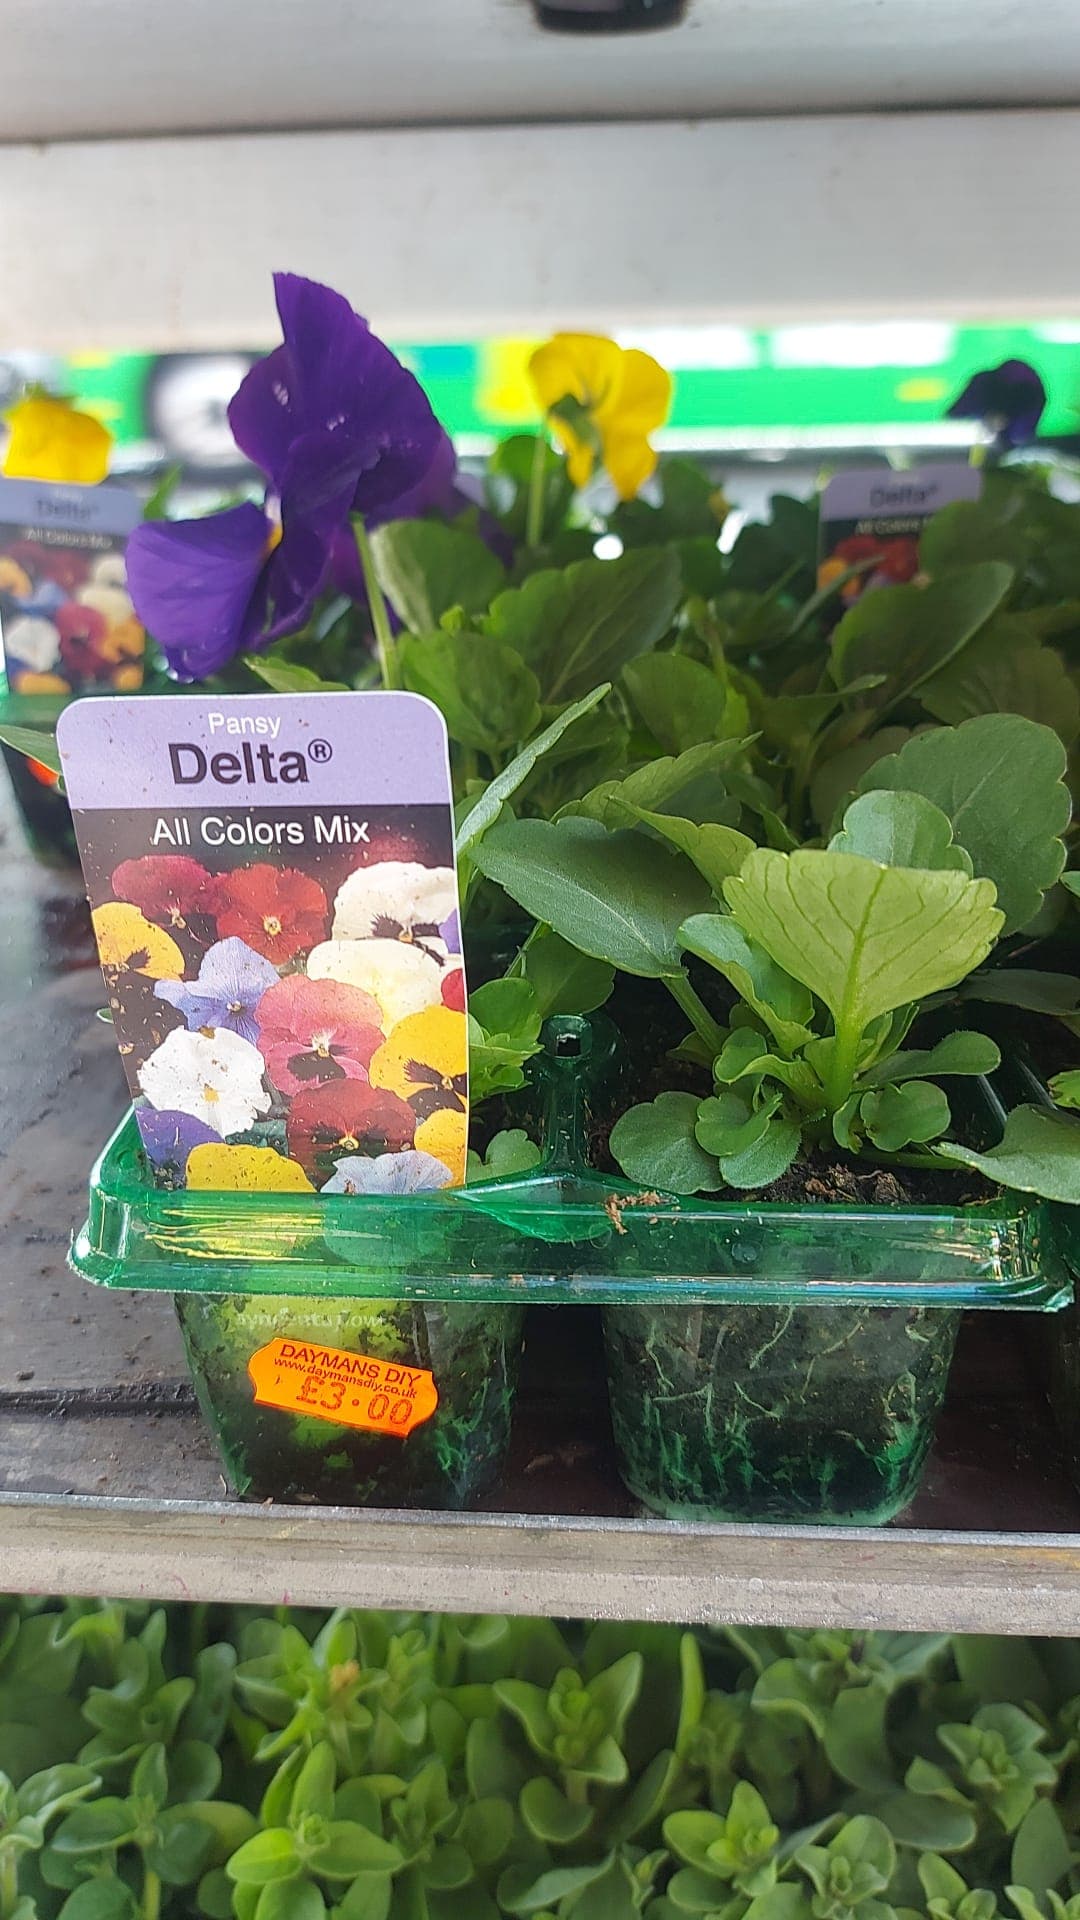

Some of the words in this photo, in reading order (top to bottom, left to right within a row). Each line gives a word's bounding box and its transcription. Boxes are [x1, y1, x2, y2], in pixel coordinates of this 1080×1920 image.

[208, 712, 281, 738] Pansy
[152, 818, 192, 846] All
[200, 815, 305, 845] Colors
[314, 814, 370, 844] Mix
[274, 1357, 418, 1399] www.daymansdiy.co.uk
[280, 1344, 380, 1379] DAYMANS
[385, 1368, 422, 1388] DIY
